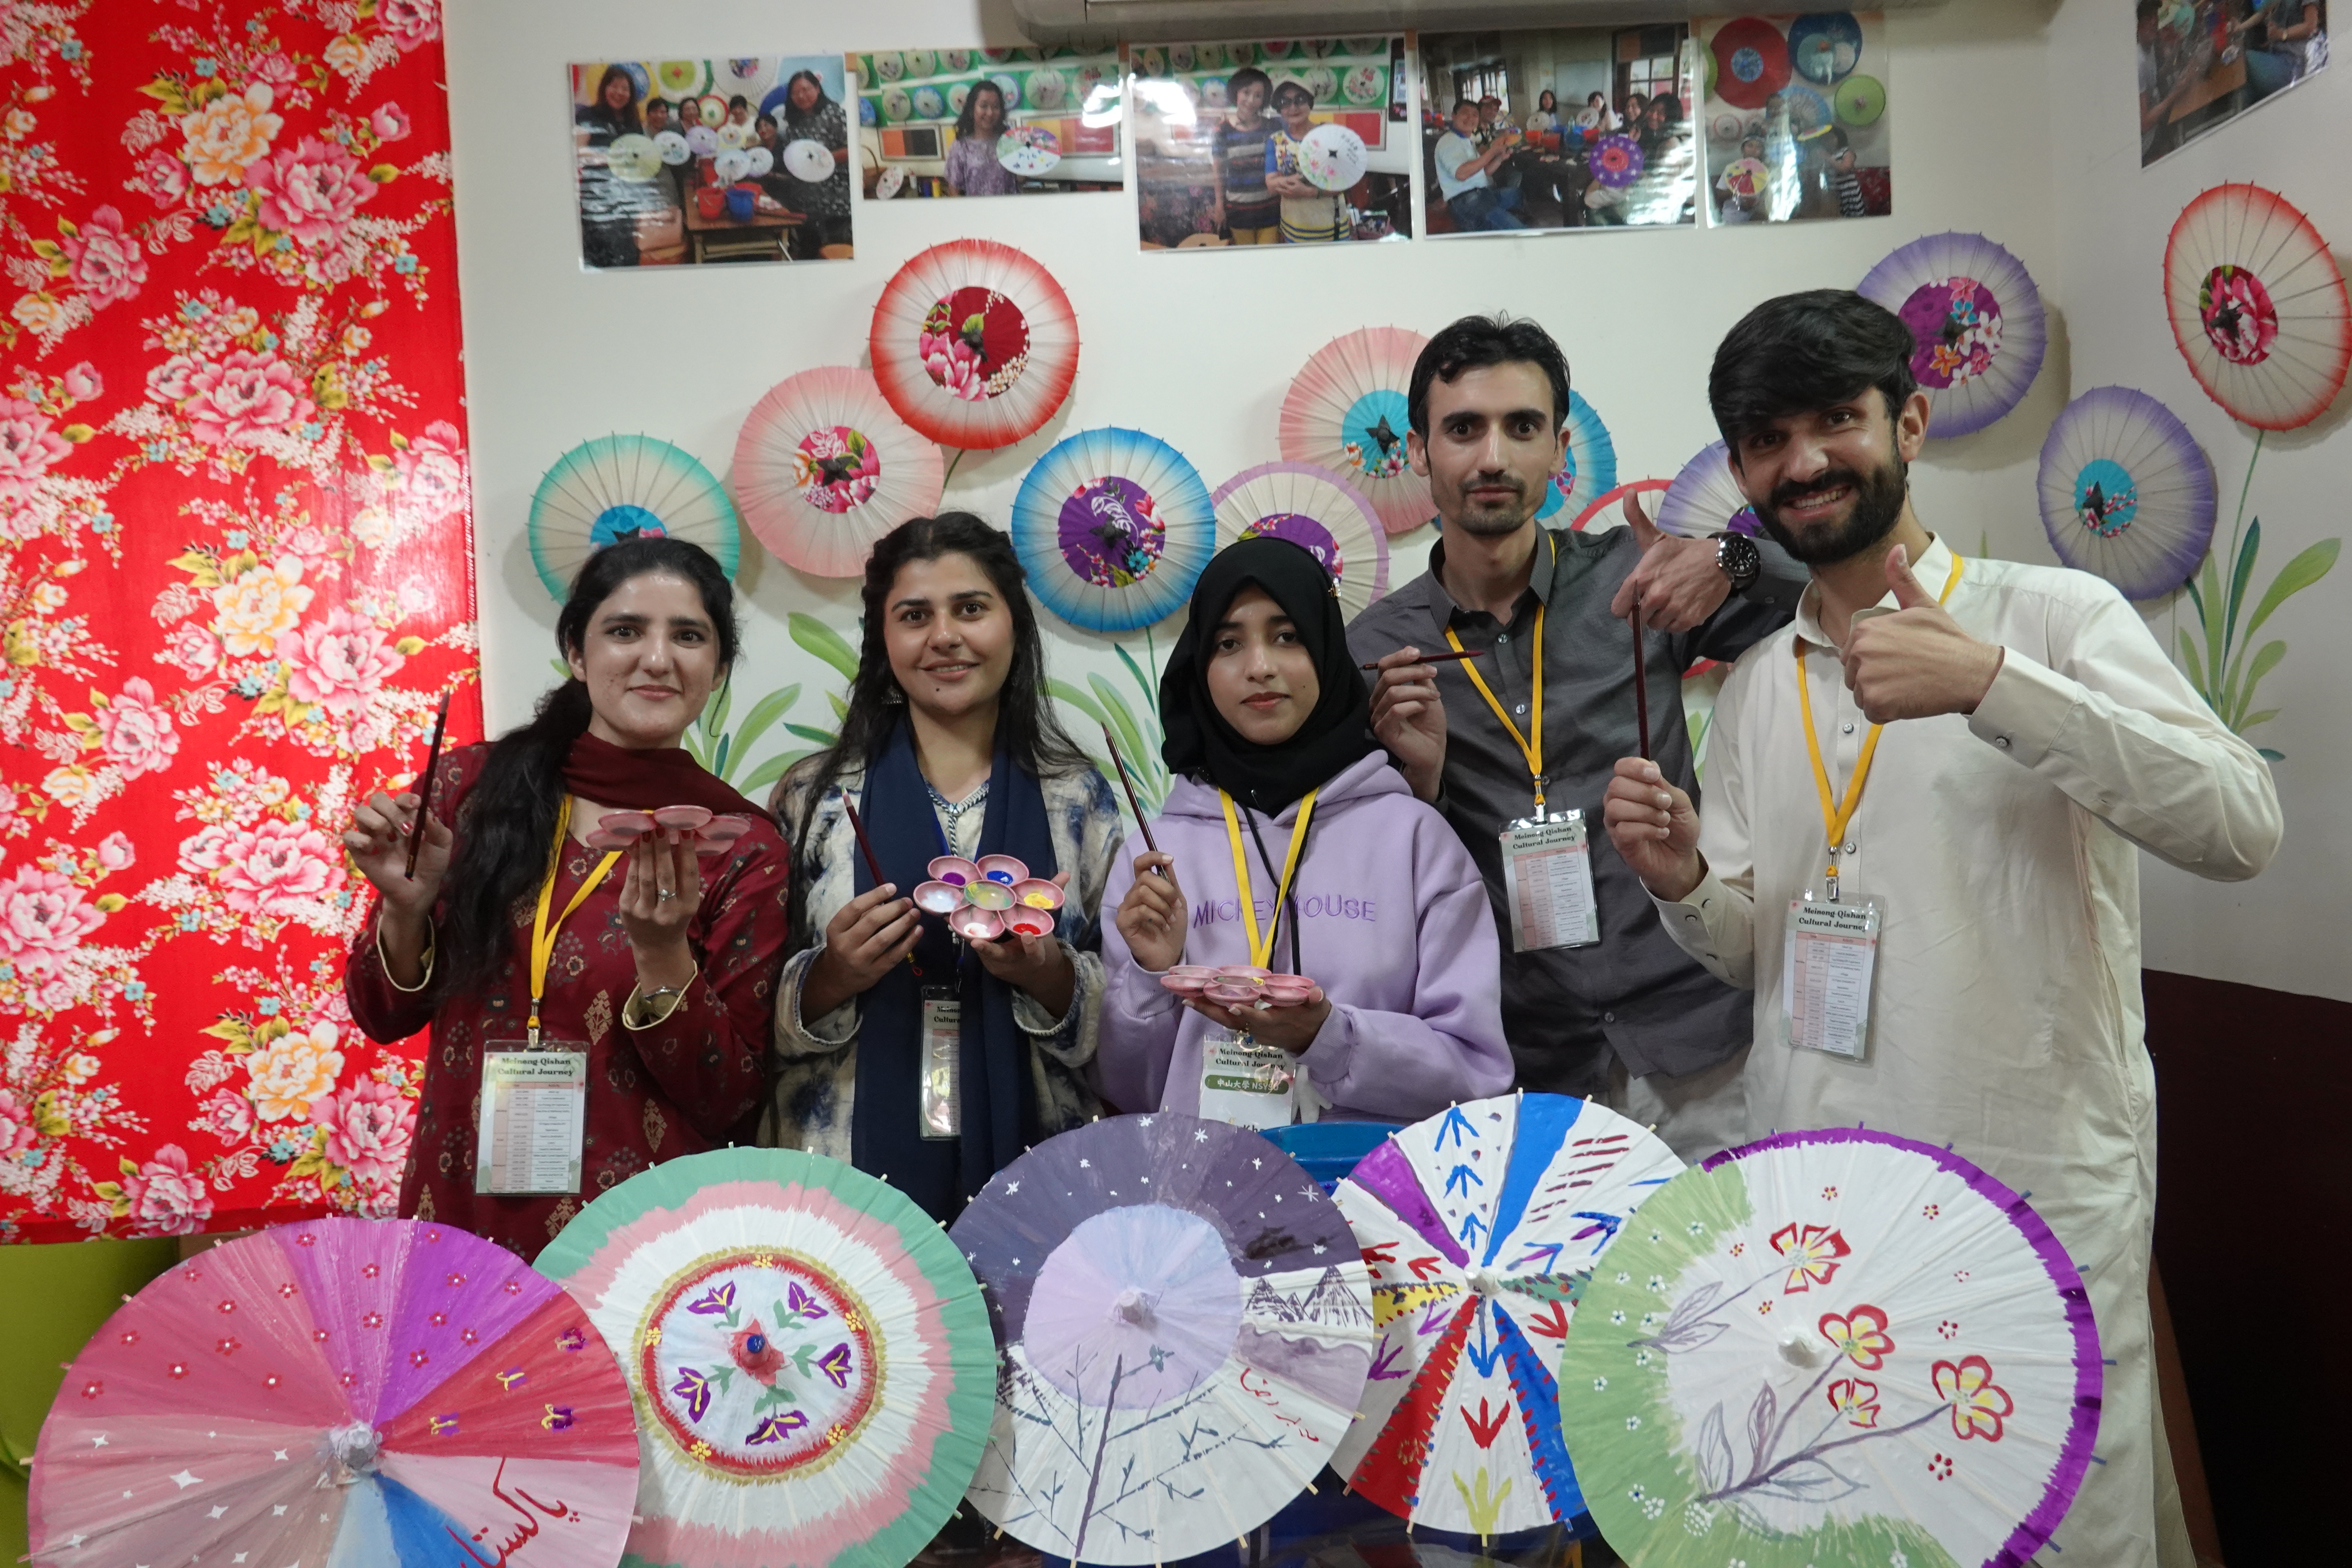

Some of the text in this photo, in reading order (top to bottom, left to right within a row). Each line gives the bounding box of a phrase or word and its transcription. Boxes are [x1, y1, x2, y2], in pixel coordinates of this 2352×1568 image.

[1513, 835, 1576, 849] Cultural Journey
[1799, 917, 1831, 927] Cultural
[538, 1069, 574, 1077] Journey
[445, 1455, 580, 1568] پاکستا
